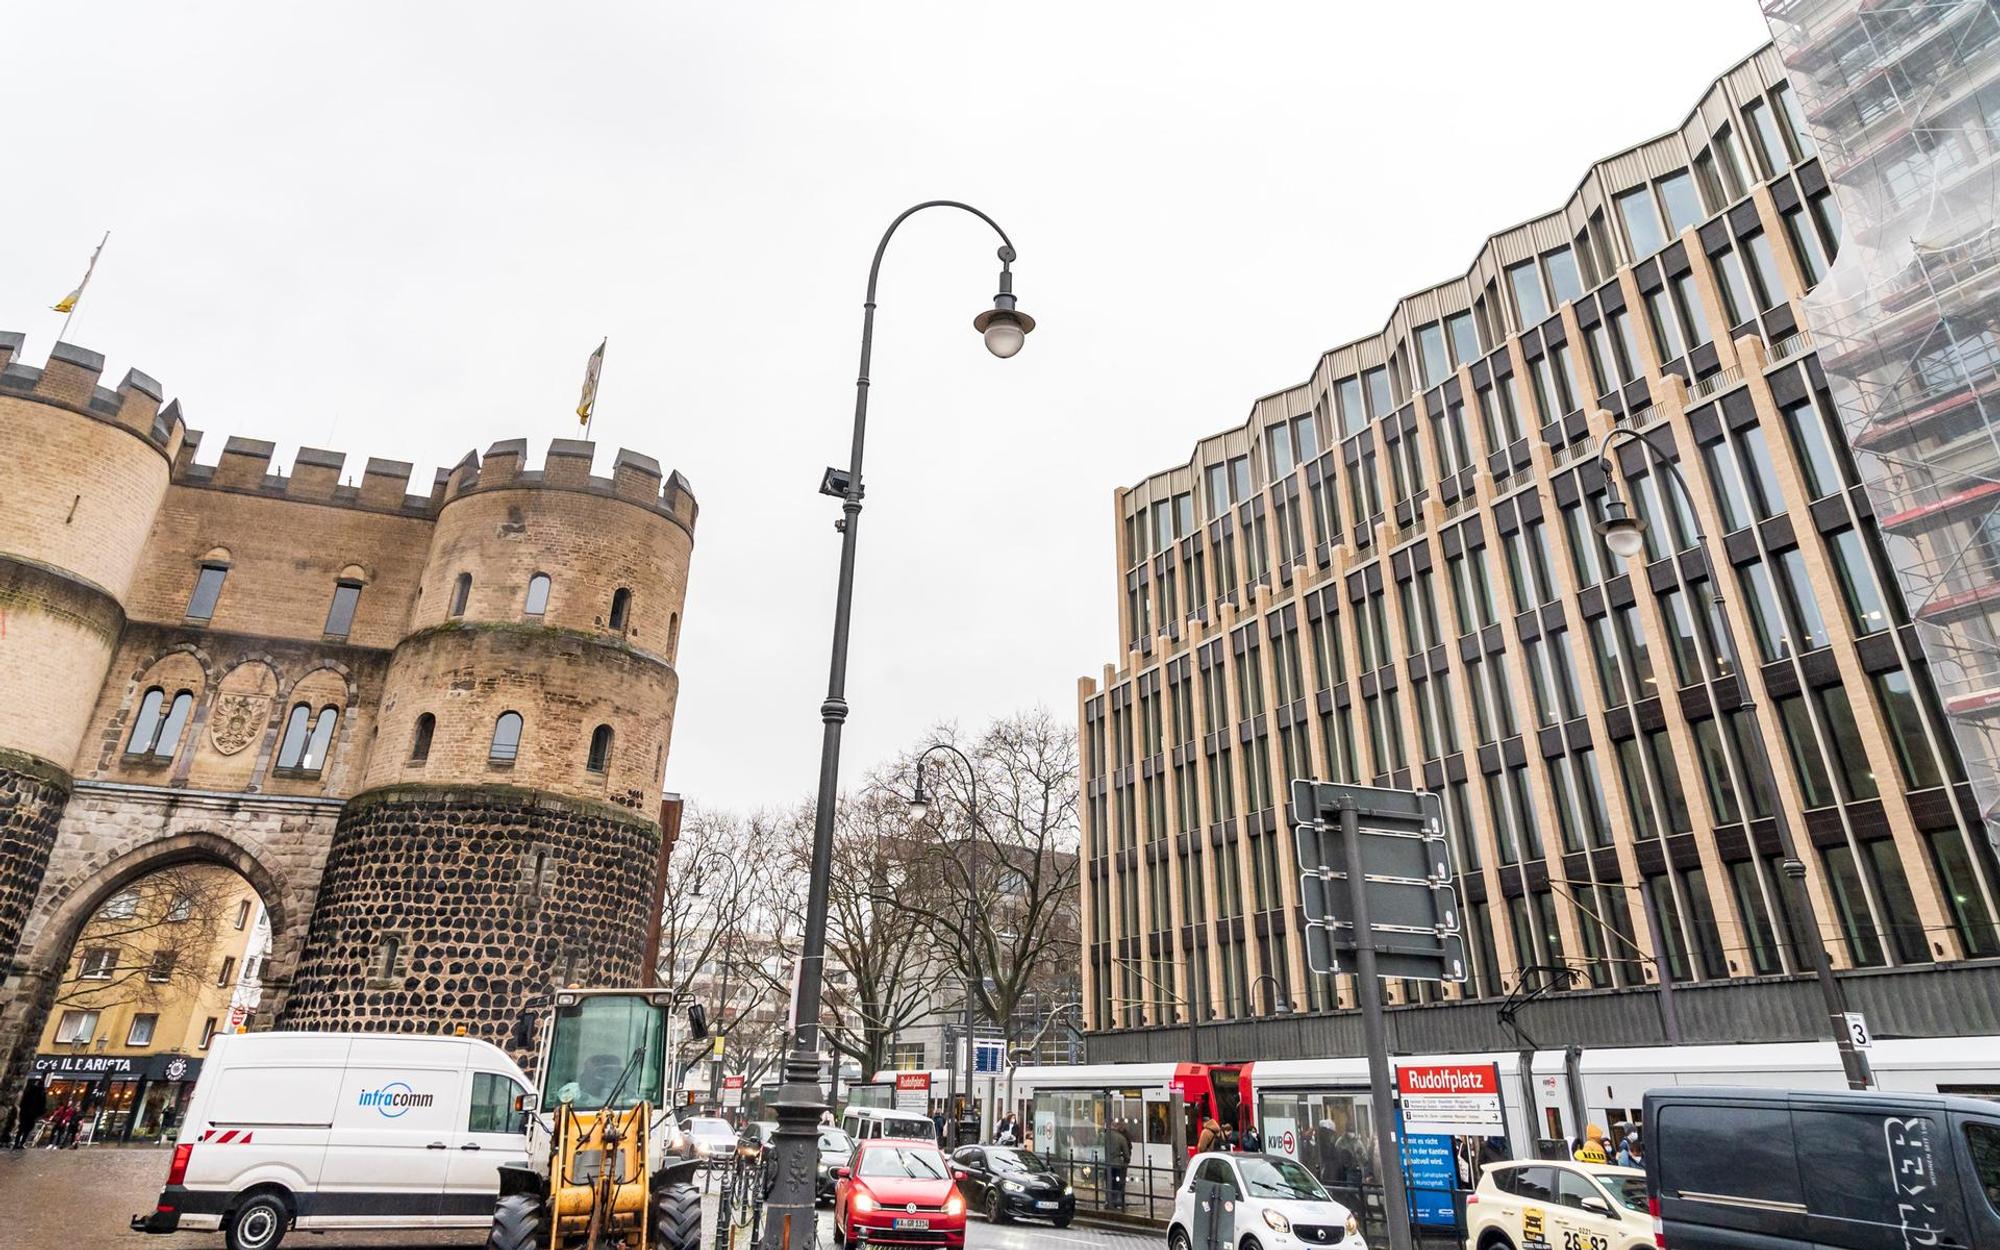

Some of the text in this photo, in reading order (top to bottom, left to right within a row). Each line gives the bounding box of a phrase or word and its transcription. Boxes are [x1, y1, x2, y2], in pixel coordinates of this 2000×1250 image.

[1852, 1024, 1867, 1045] 3
[61, 1058, 73, 1070] IL
[1408, 1069, 1484, 1093] Rudolfplatz
[359, 1089, 433, 1107] infracomm
[1268, 1135, 1283, 1149] KVB
[1401, 1137, 1418, 1145] Dmit
[1403, 1158, 1430, 1166] ghaltvoll
